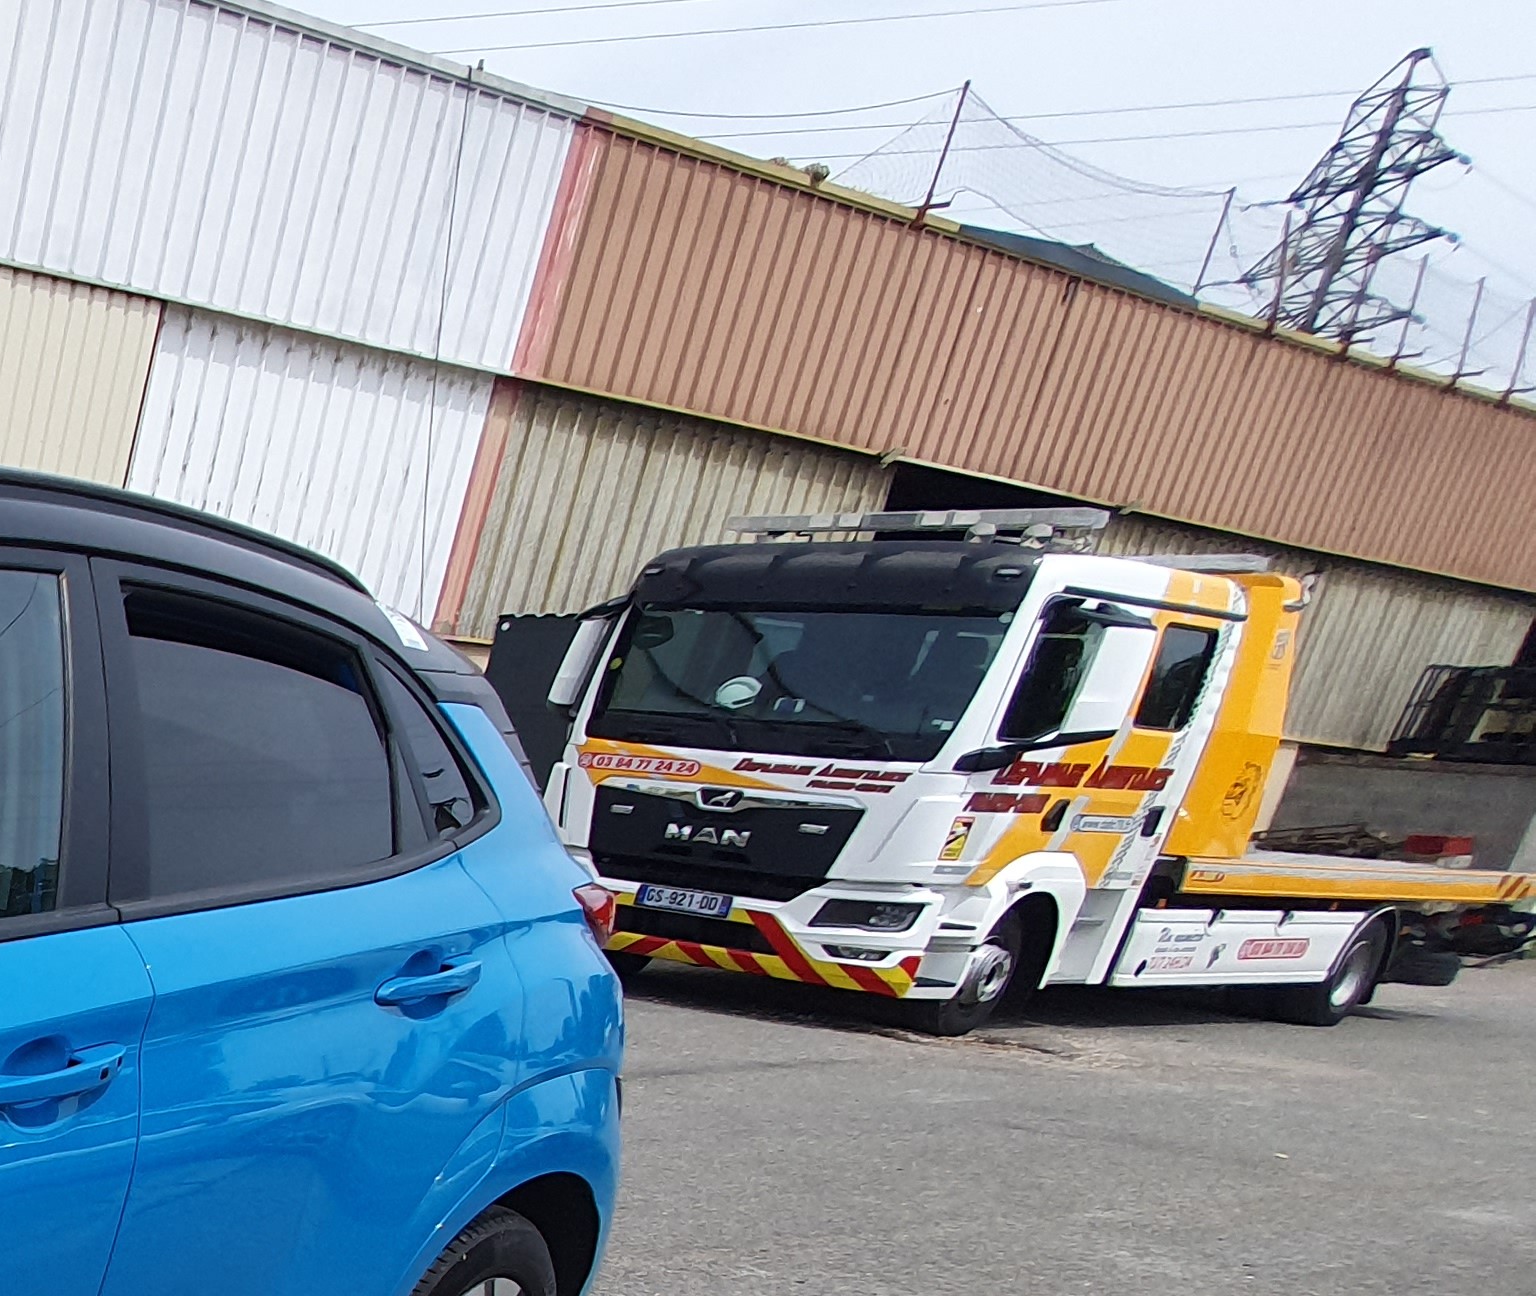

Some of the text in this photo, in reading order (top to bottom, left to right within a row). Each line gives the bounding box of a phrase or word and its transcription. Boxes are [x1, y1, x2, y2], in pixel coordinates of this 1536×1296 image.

[596, 756, 613, 767] 03
[634, 759, 652, 770] 77
[654, 760, 673, 772] 24
[676, 762, 696, 773] 24
[664, 822, 752, 849] MAN
